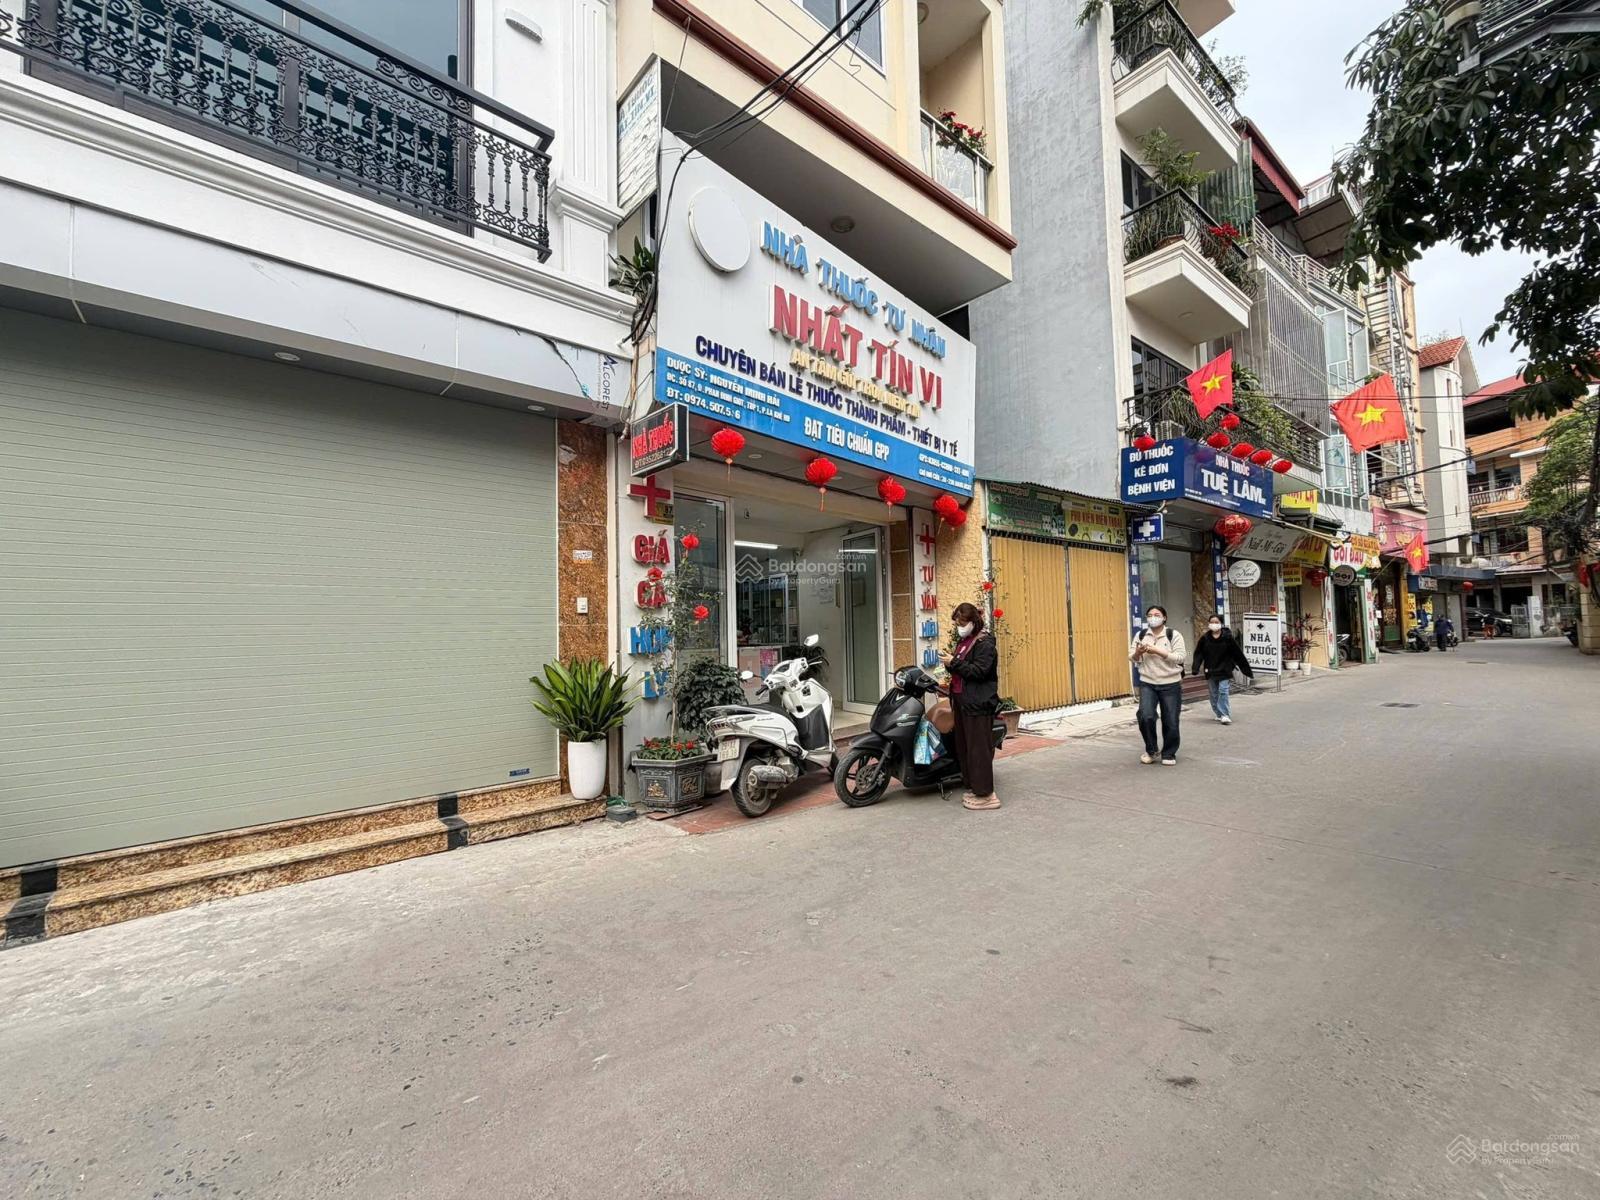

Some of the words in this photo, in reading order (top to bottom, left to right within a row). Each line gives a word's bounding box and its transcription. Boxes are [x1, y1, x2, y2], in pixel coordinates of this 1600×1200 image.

[760, 221, 809, 275] NHÀ
[816, 257, 878, 316] THUỐC
[882, 301, 905, 332] TƯ
[908, 318, 946, 360] NHÂN
[770, 285, 863, 368] NHẤT
[868, 339, 913, 395] TÍN
[666, 357, 691, 375] DƯỢC
[710, 374, 743, 394] NGUYỄN
[790, 349, 811, 369] AN
[811, 357, 838, 385] TÂM
[667, 387, 682, 400] ĐT:
[696, 335, 756, 378] CHUYÊN
[760, 362, 786, 389] BÁN
[789, 372, 803, 396] LẺ
[806, 382, 843, 412] THUỐC
[845, 399, 878, 425] THÀNH
[880, 410, 906, 436] PHẨM
[912, 427, 933, 447] THIẾT
[934, 436, 941, 455] BỊ
[942, 440, 948, 454] Y
[949, 440, 958, 457] TẾ
[632, 427, 647, 459] NHÀ
[648, 412, 673, 452] THUỐC
[804, 416, 822, 442] ĐẠT
[826, 424, 845, 447] TIÊU
[847, 431, 873, 457] CHUẨN
[875, 440, 889, 462] GPP
[1144, 443, 1173, 460] THUỐC
[1134, 465, 1147, 478] KÊ
[1148, 463, 1168, 476] ĐƠN
[1215, 455, 1229, 470] NHÀ
[1231, 457, 1250, 477] THUỐC
[1127, 480, 1151, 496] BỆNH
[1154, 478, 1175, 492] VIỆN
[1201, 468, 1229, 496] TUỆ
[1233, 479, 1263, 505] LÂM
[631, 529, 670, 565] GIÁ
[1245, 643, 1277, 656] THUỐC
[1250, 632, 1271, 642] NHÀ
[1262, 657, 1275, 666] TỐT
